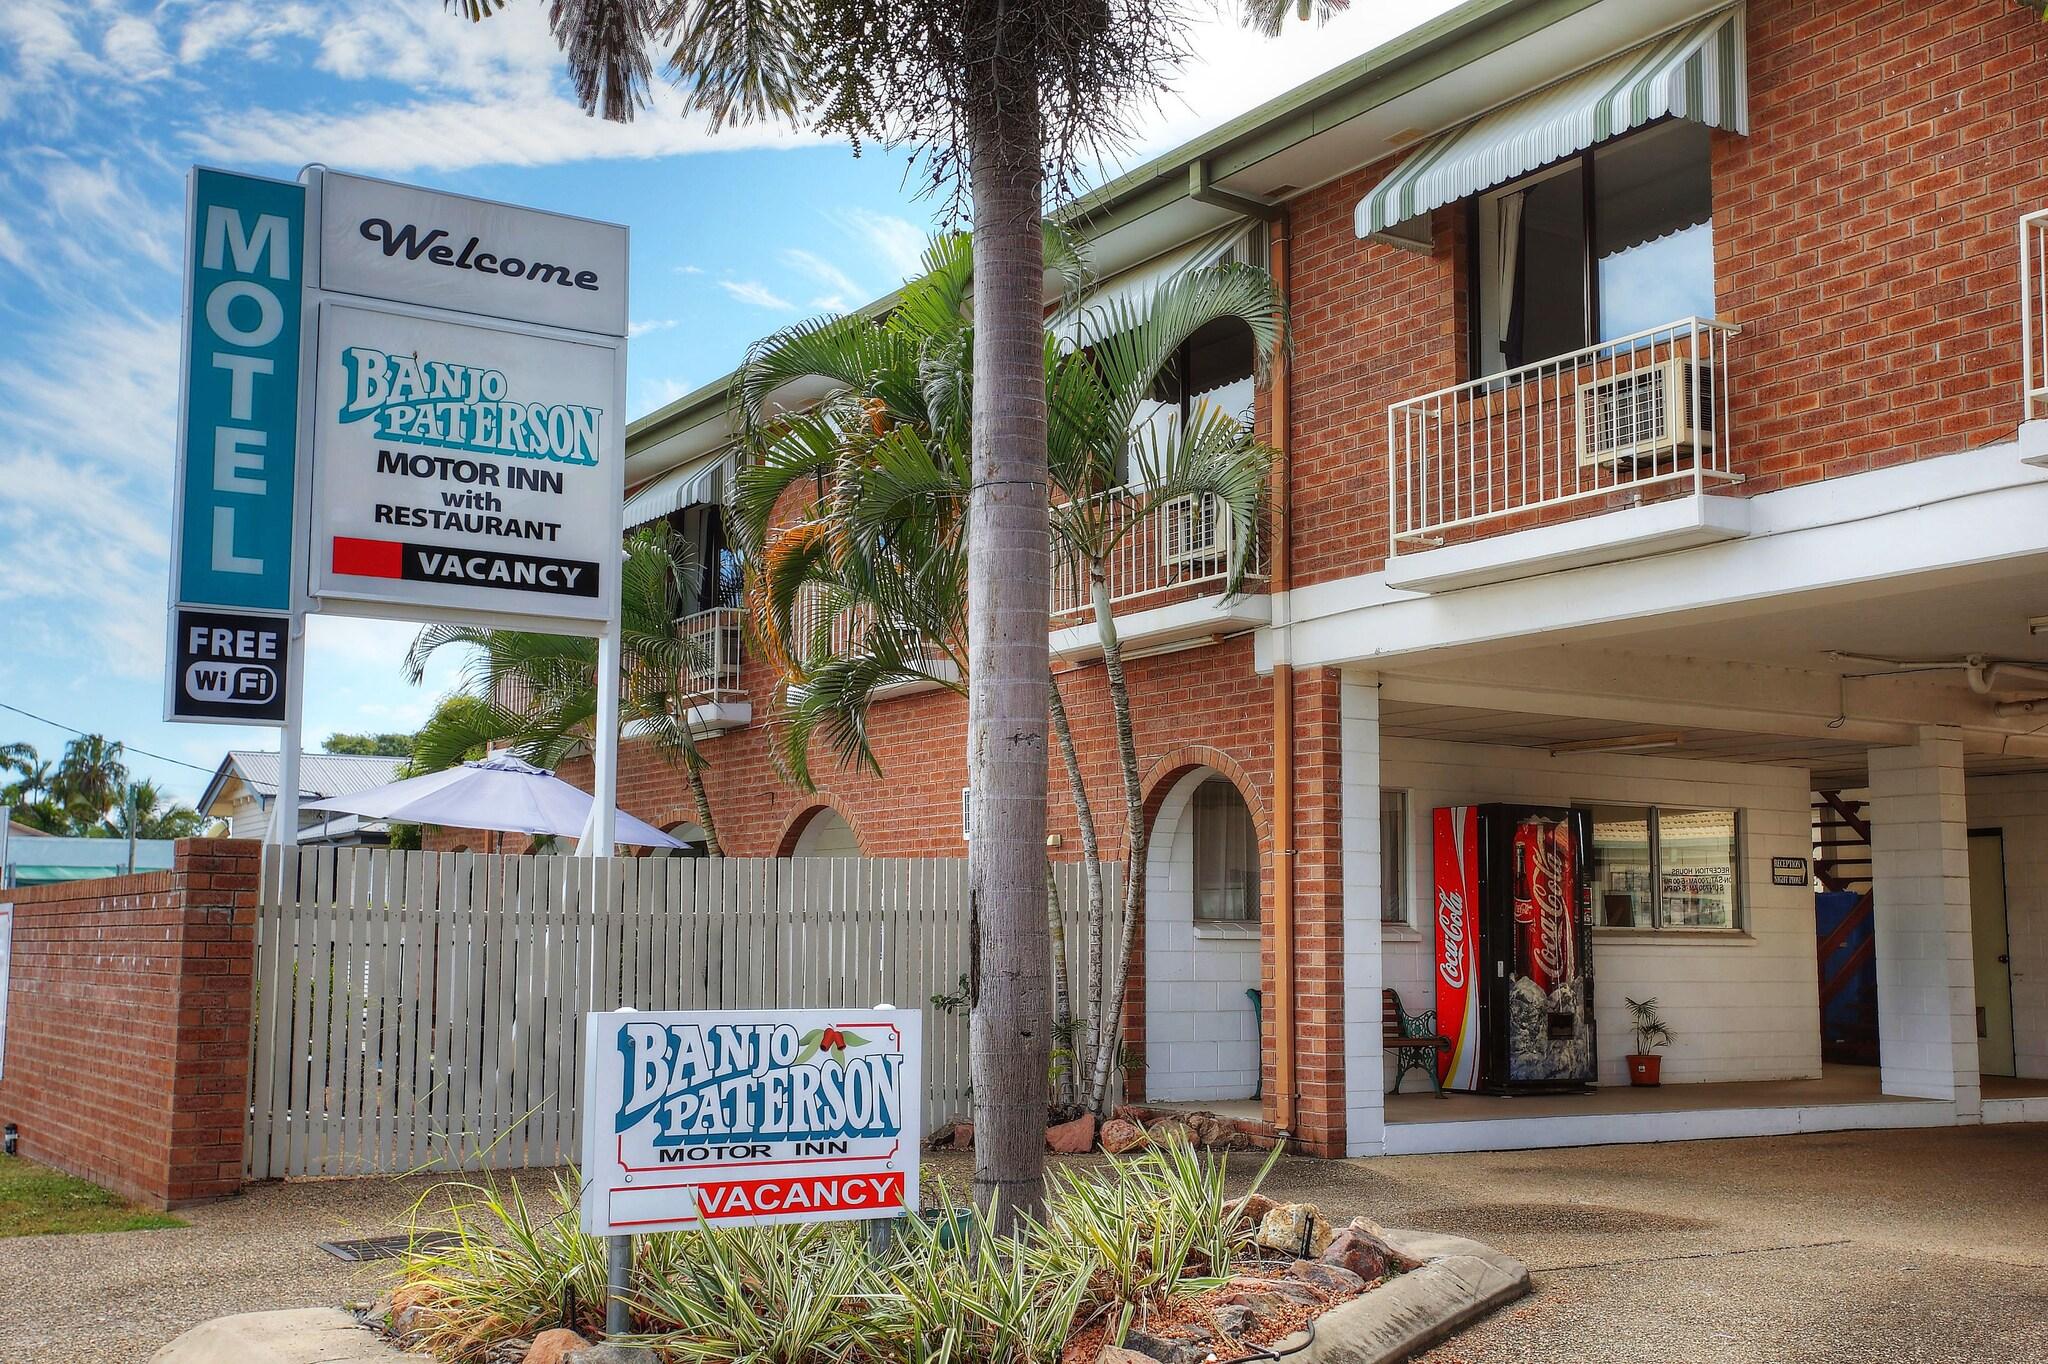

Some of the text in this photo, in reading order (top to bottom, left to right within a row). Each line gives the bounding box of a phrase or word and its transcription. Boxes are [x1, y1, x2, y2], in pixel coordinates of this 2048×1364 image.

[359, 217, 600, 292] Welcome
[202, 205, 291, 576] MOTEL
[340, 346, 508, 424] BANJO
[374, 400, 604, 467] PATERSON
[376, 449, 564, 495] MOTOR INN
[375, 504, 562, 542] RESTAURANT
[441, 489, 502, 513] with
[416, 551, 582, 589] VACANCY
[189, 626, 277, 660] FREE
[616, 1022, 799, 1134] BANJO
[653, 1054, 904, 1146] PATERSON
[659, 1141, 848, 1163] MOTOR INN
[698, 1177, 898, 1214] VACANCY
